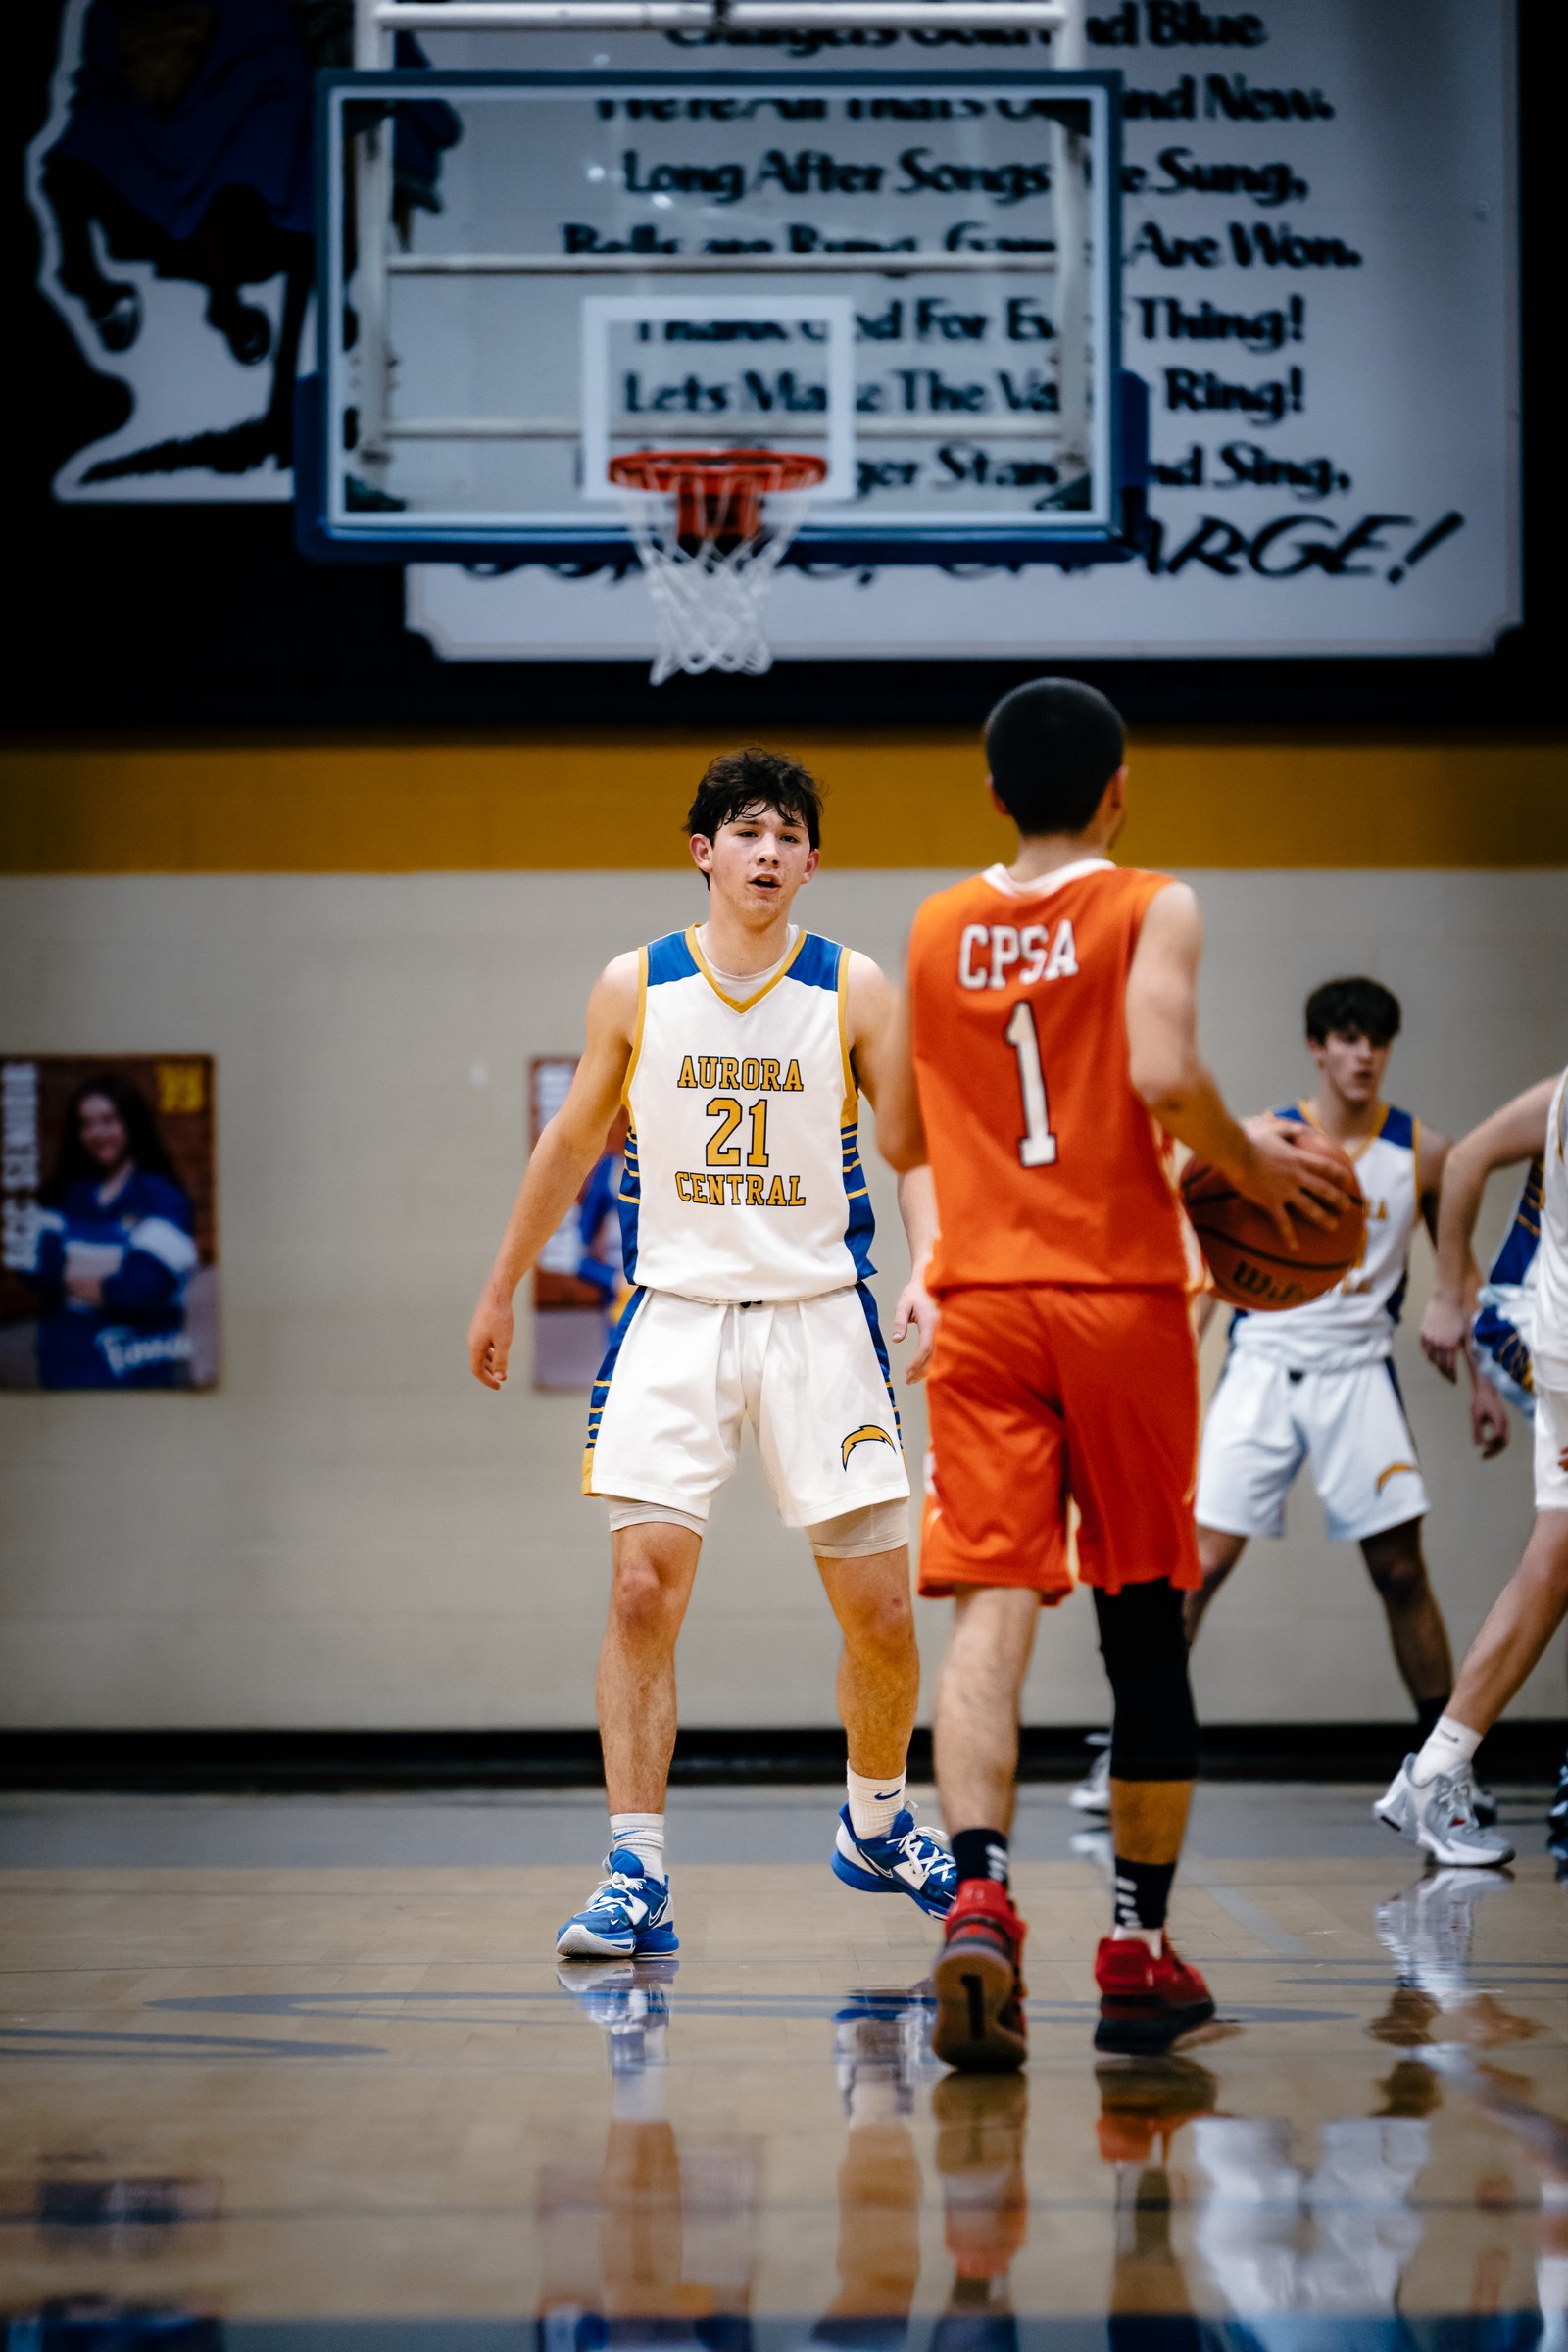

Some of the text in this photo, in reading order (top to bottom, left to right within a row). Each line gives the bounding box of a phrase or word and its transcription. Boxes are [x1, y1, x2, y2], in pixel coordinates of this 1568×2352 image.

[1145, 0, 1269, 47] Blue
[622, 149, 745, 204] Long
[753, 149, 886, 193] After
[1127, 221, 1219, 267] Are
[917, 297, 987, 340] For
[624, 371, 729, 413] Lets
[741, 369, 883, 413] Mae
[893, 368, 986, 412] The
[1163, 366, 1305, 427] Ring!
[958, 918, 1079, 991] CPSA
[677, 1055, 804, 1092] AURORA
[1004, 999, 1057, 1167] 1
[706, 1097, 769, 1167] 21
[674, 1171, 806, 1206] CENTRAL
